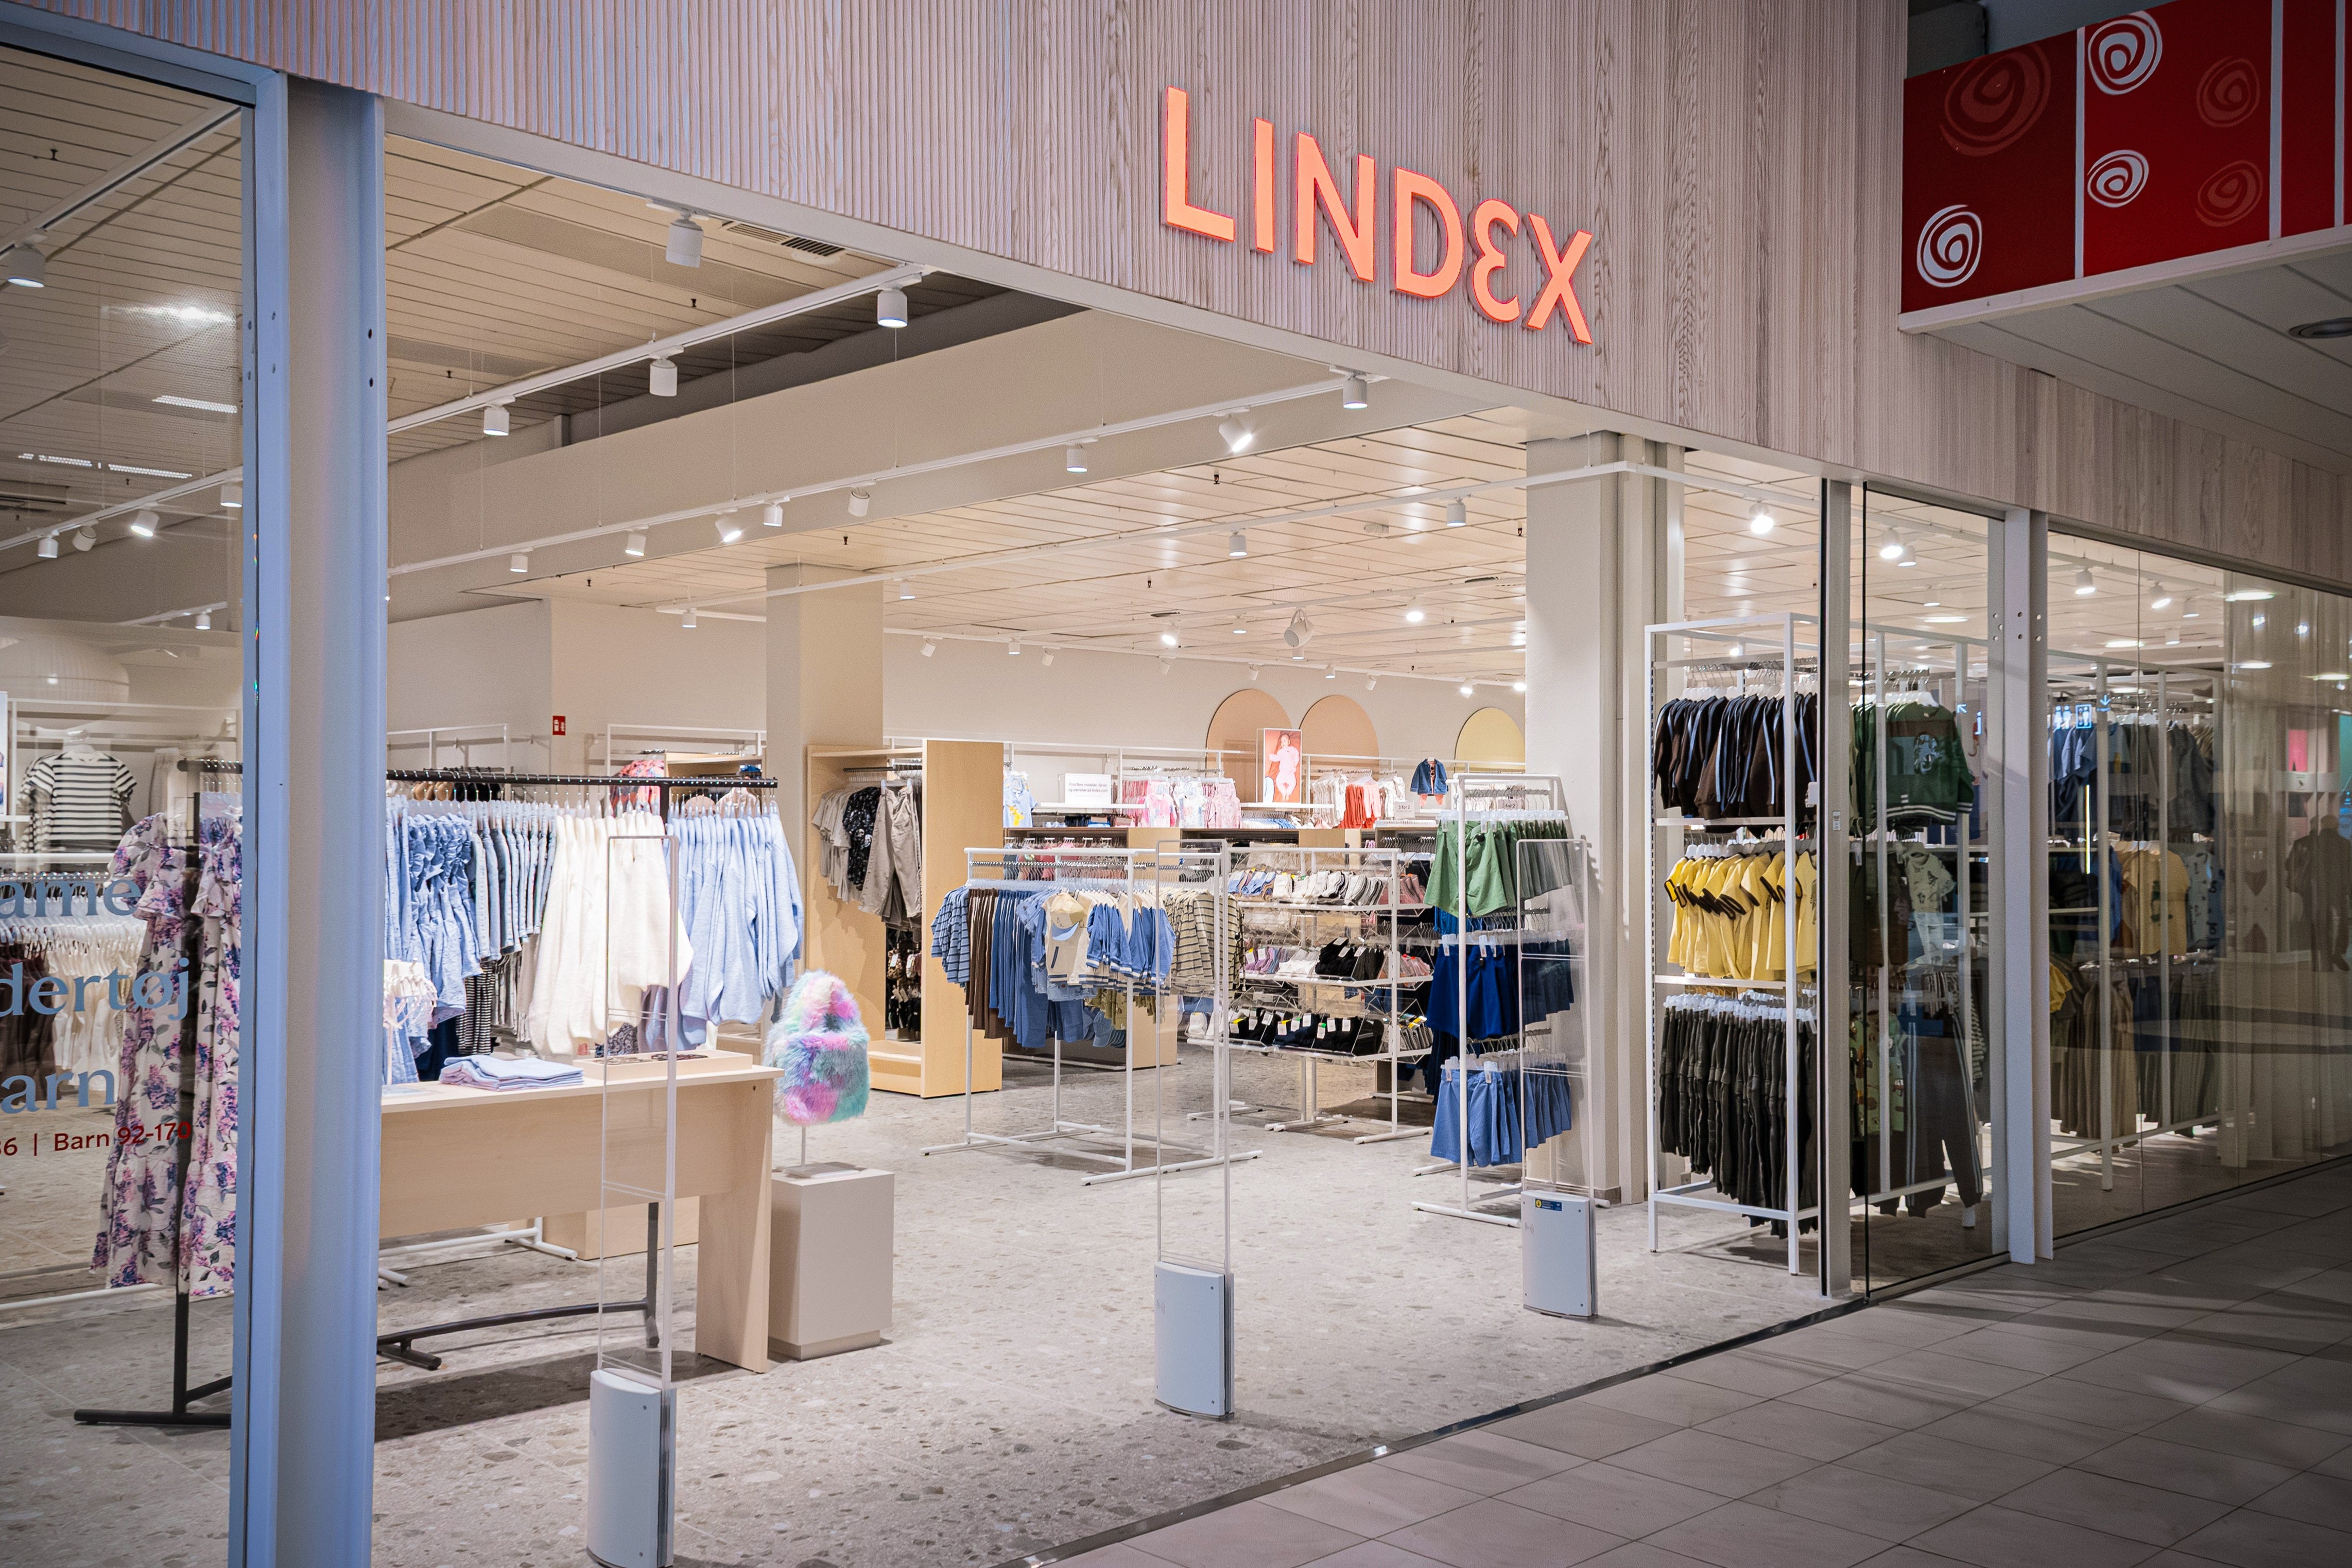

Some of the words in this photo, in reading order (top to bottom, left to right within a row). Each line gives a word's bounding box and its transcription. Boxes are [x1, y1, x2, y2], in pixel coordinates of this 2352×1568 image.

[1166, 85, 1593, 345] LINDEX
[54, 1133, 110, 1151] Barn
[117, 1121, 192, 1145] 92-170
